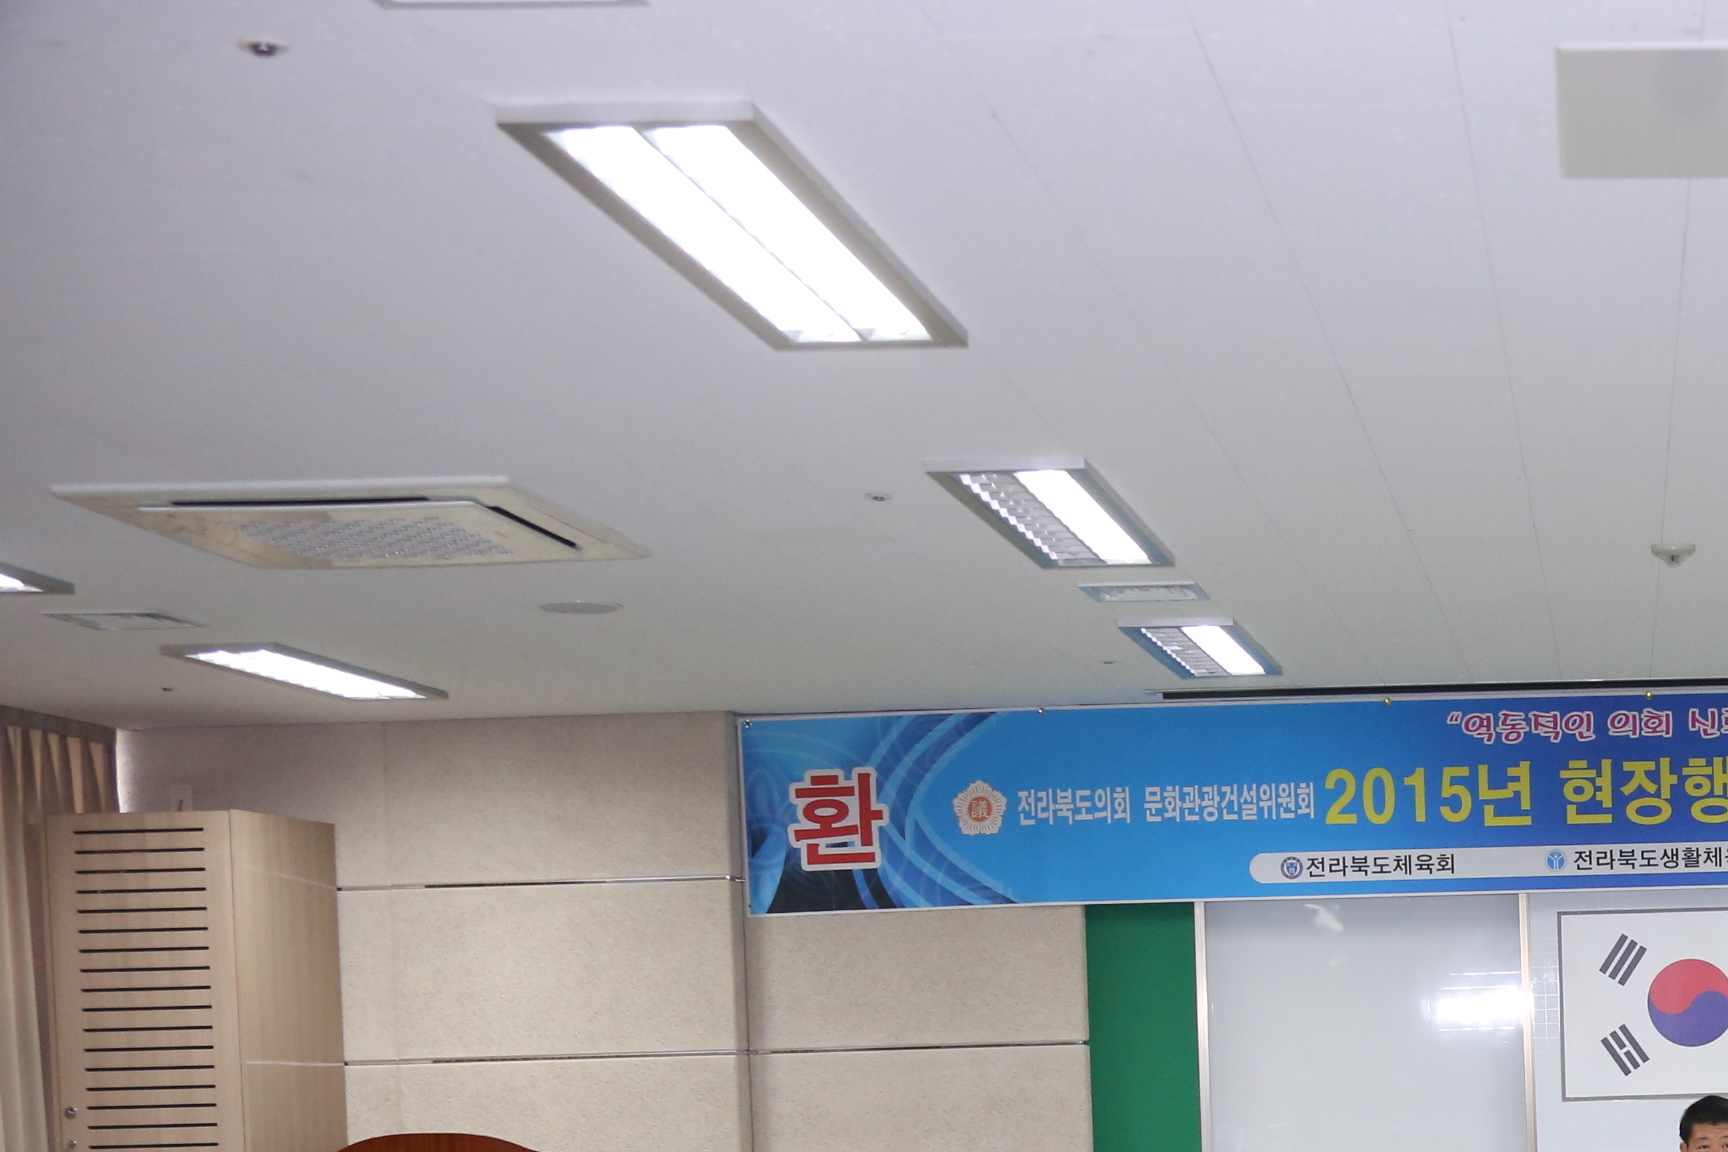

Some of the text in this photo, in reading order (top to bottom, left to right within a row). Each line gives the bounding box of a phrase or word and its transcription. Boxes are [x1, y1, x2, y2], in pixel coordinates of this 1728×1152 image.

[1608, 708, 1674, 738] 의회
[1018, 782, 1315, 826] 전라북도의회 문화관광건설위원회
[1325, 760, 1534, 828] 2015년
[792, 770, 886, 867] 환
[1306, 853, 1456, 879] 전라북도체육회
